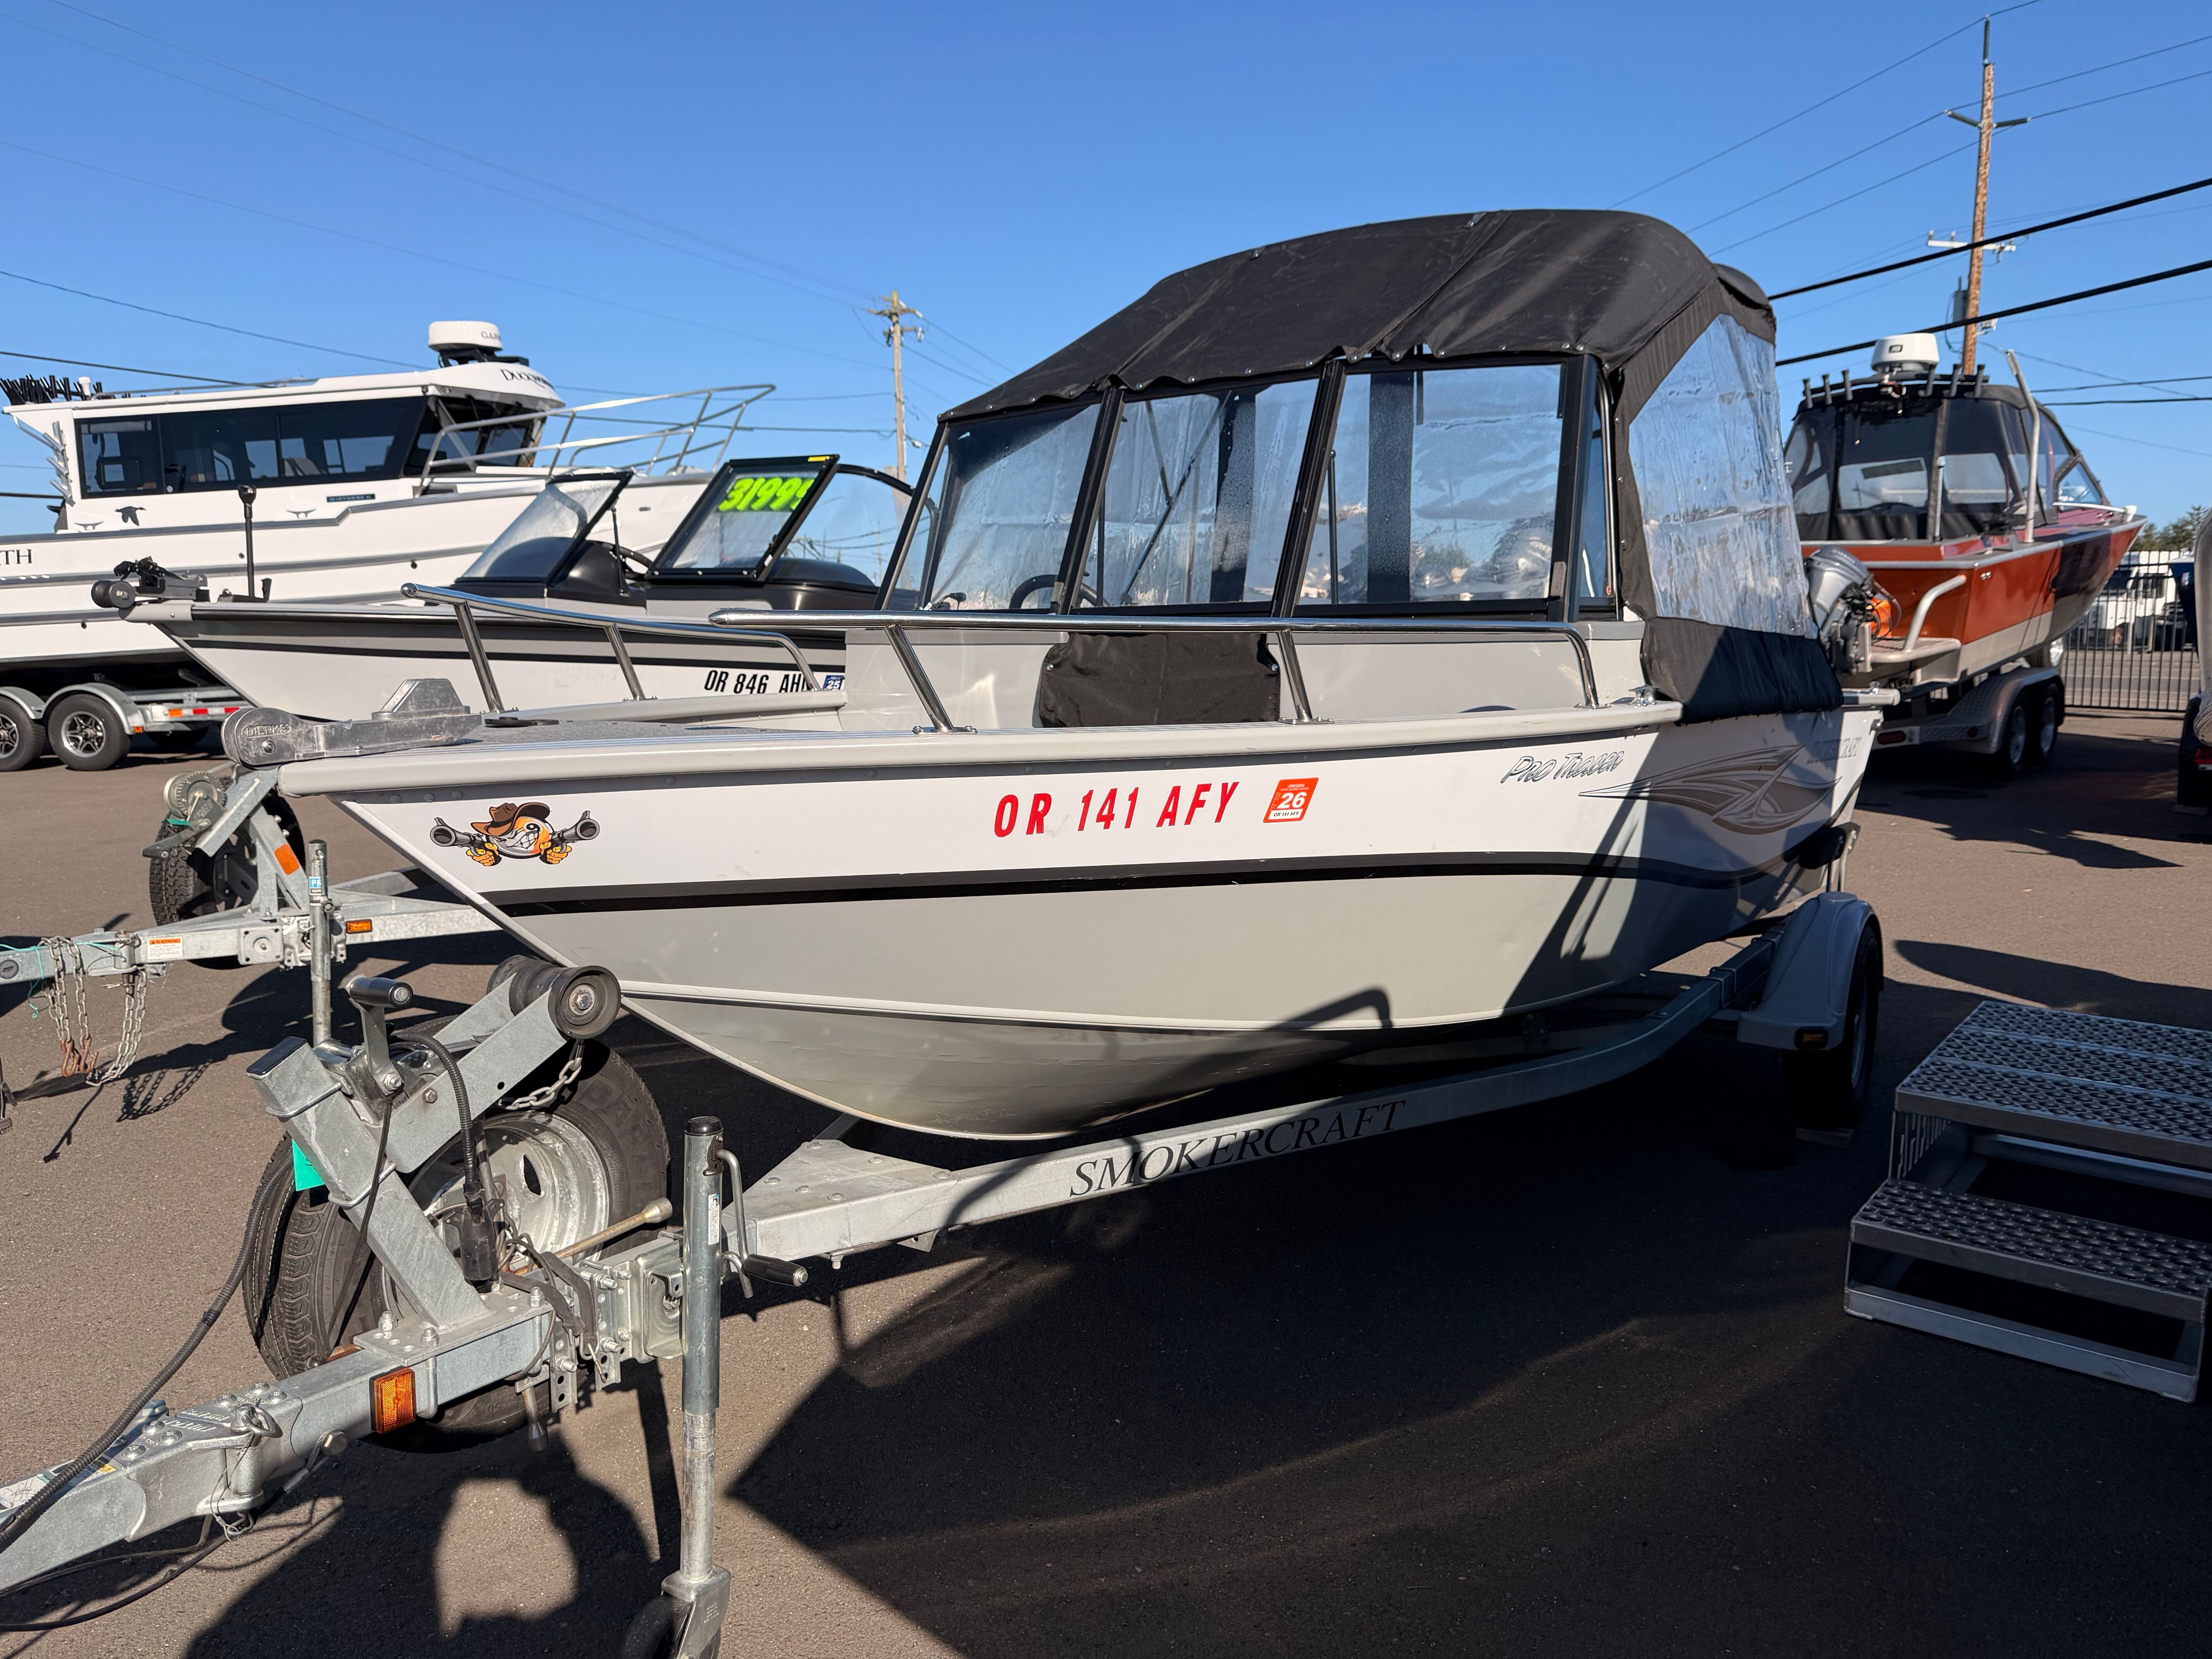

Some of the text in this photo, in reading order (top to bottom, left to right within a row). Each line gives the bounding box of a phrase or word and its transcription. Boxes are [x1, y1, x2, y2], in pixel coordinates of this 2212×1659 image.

[0, 548, 33, 565] TH
[704, 670, 729, 692] OR
[733, 673, 769, 694] 846
[826, 680, 841, 690] 25
[246, 724, 289, 736] DIERKS
[994, 793, 1052, 837] OR
[1077, 787, 1139, 831] 141
[1156, 781, 1240, 828] AFY
[1276, 792, 1307, 809] 26
[1069, 1100, 1407, 1198] SMOKERCRAFT
